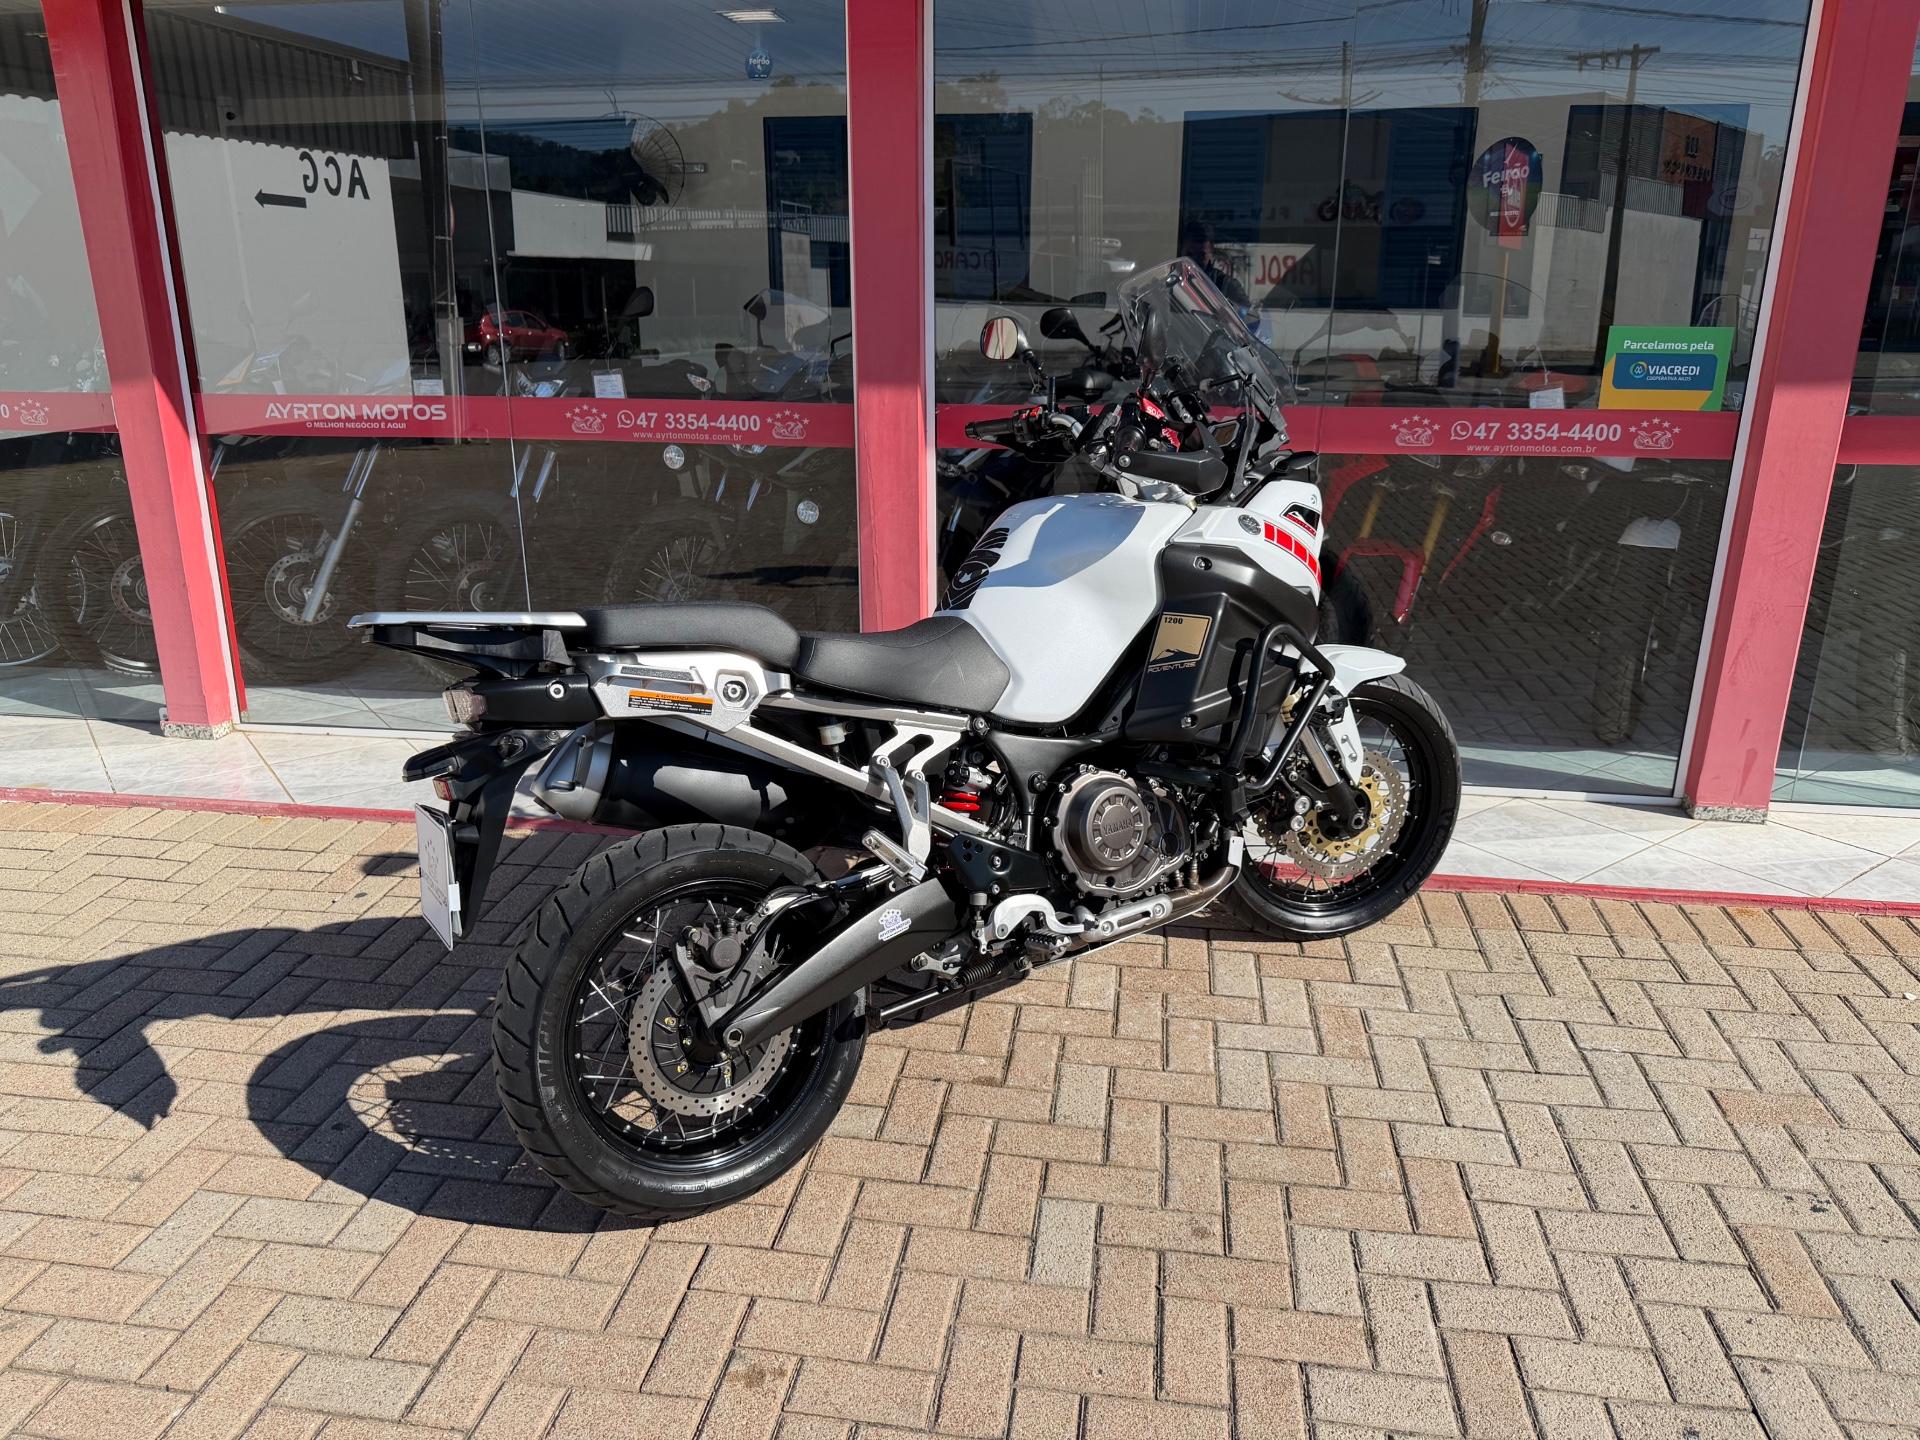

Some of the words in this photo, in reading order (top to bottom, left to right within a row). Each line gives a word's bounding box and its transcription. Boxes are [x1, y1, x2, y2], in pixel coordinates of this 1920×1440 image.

[1623, 340, 1688, 350] Parcelamos
[1689, 340, 1715, 352] pela
[1648, 365, 1700, 376] VIACREDI
[265, 403, 355, 420] AYRTON
[361, 404, 447, 421] MOTOS
[345, 420, 379, 429] NEGÓCIO
[636, 412, 658, 429] 47
[665, 412, 761, 431] 3354-4400
[632, 431, 743, 441] www.ayrtonmotos.com.br
[1473, 422, 1500, 440] 47
[1507, 422, 1622, 442] 3354-4400
[1466, 444, 1598, 454] www.ayrtonmotos.com.br
[1164, 616, 1184, 625] 1200
[1103, 818, 1134, 835] YAMAHA
